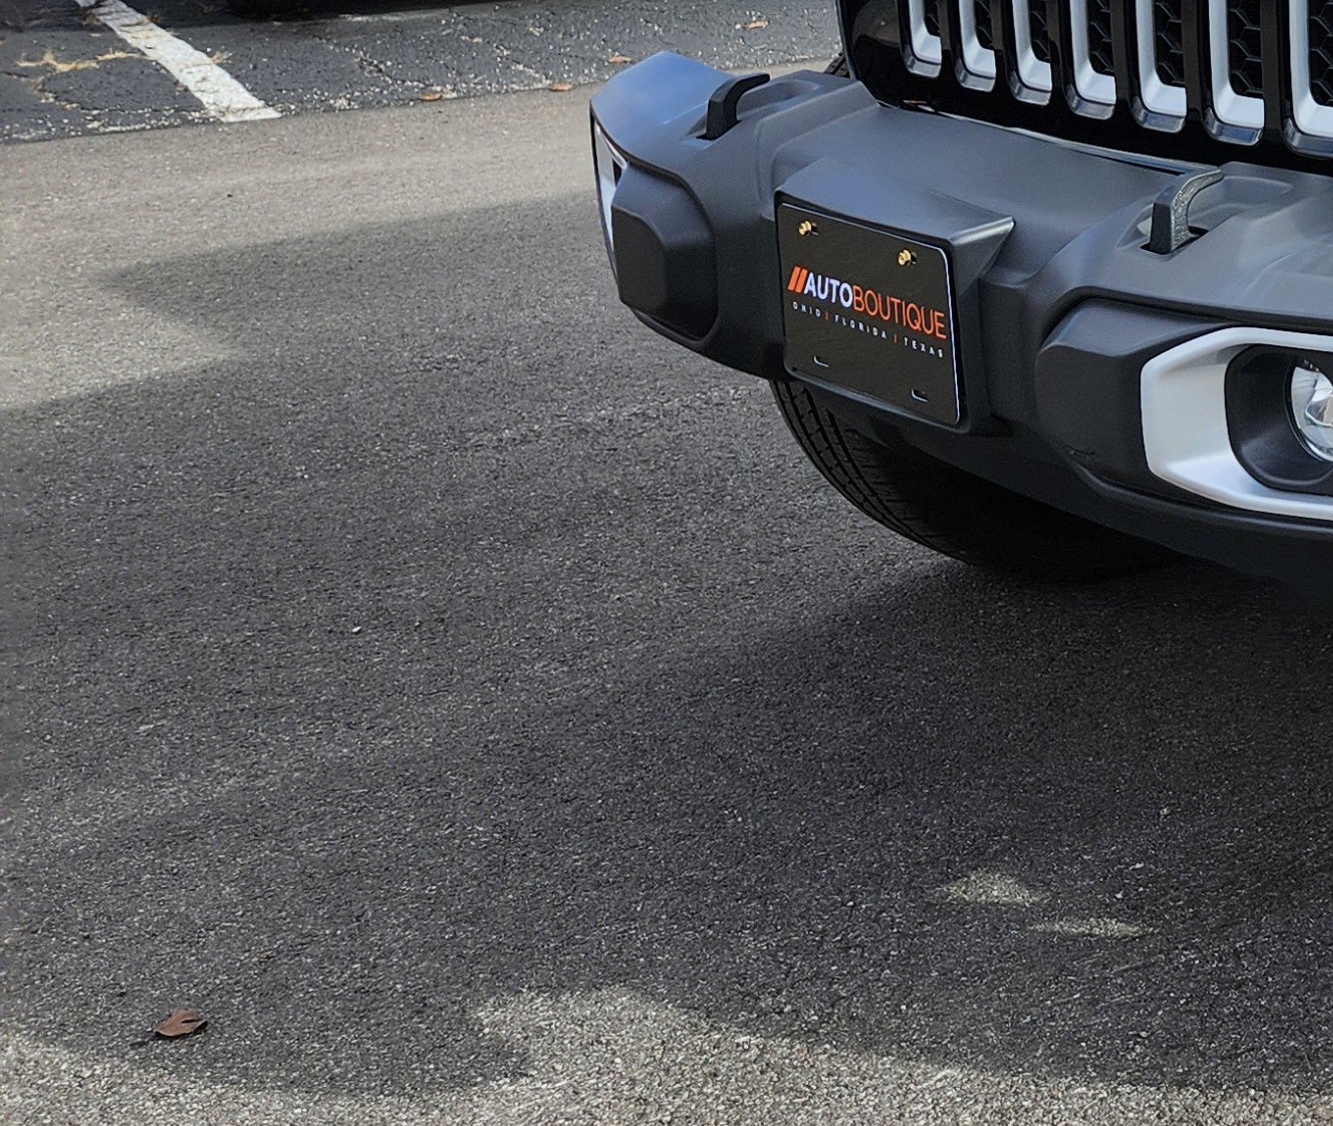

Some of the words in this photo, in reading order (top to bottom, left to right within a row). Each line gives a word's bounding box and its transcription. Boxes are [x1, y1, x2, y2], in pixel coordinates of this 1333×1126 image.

[792, 301, 822, 318] OHIO
[834, 314, 888, 339] FLORIDA
[904, 336, 944, 358] TEXAS
[803, 271, 948, 340] AUTOBOUTIQUE
